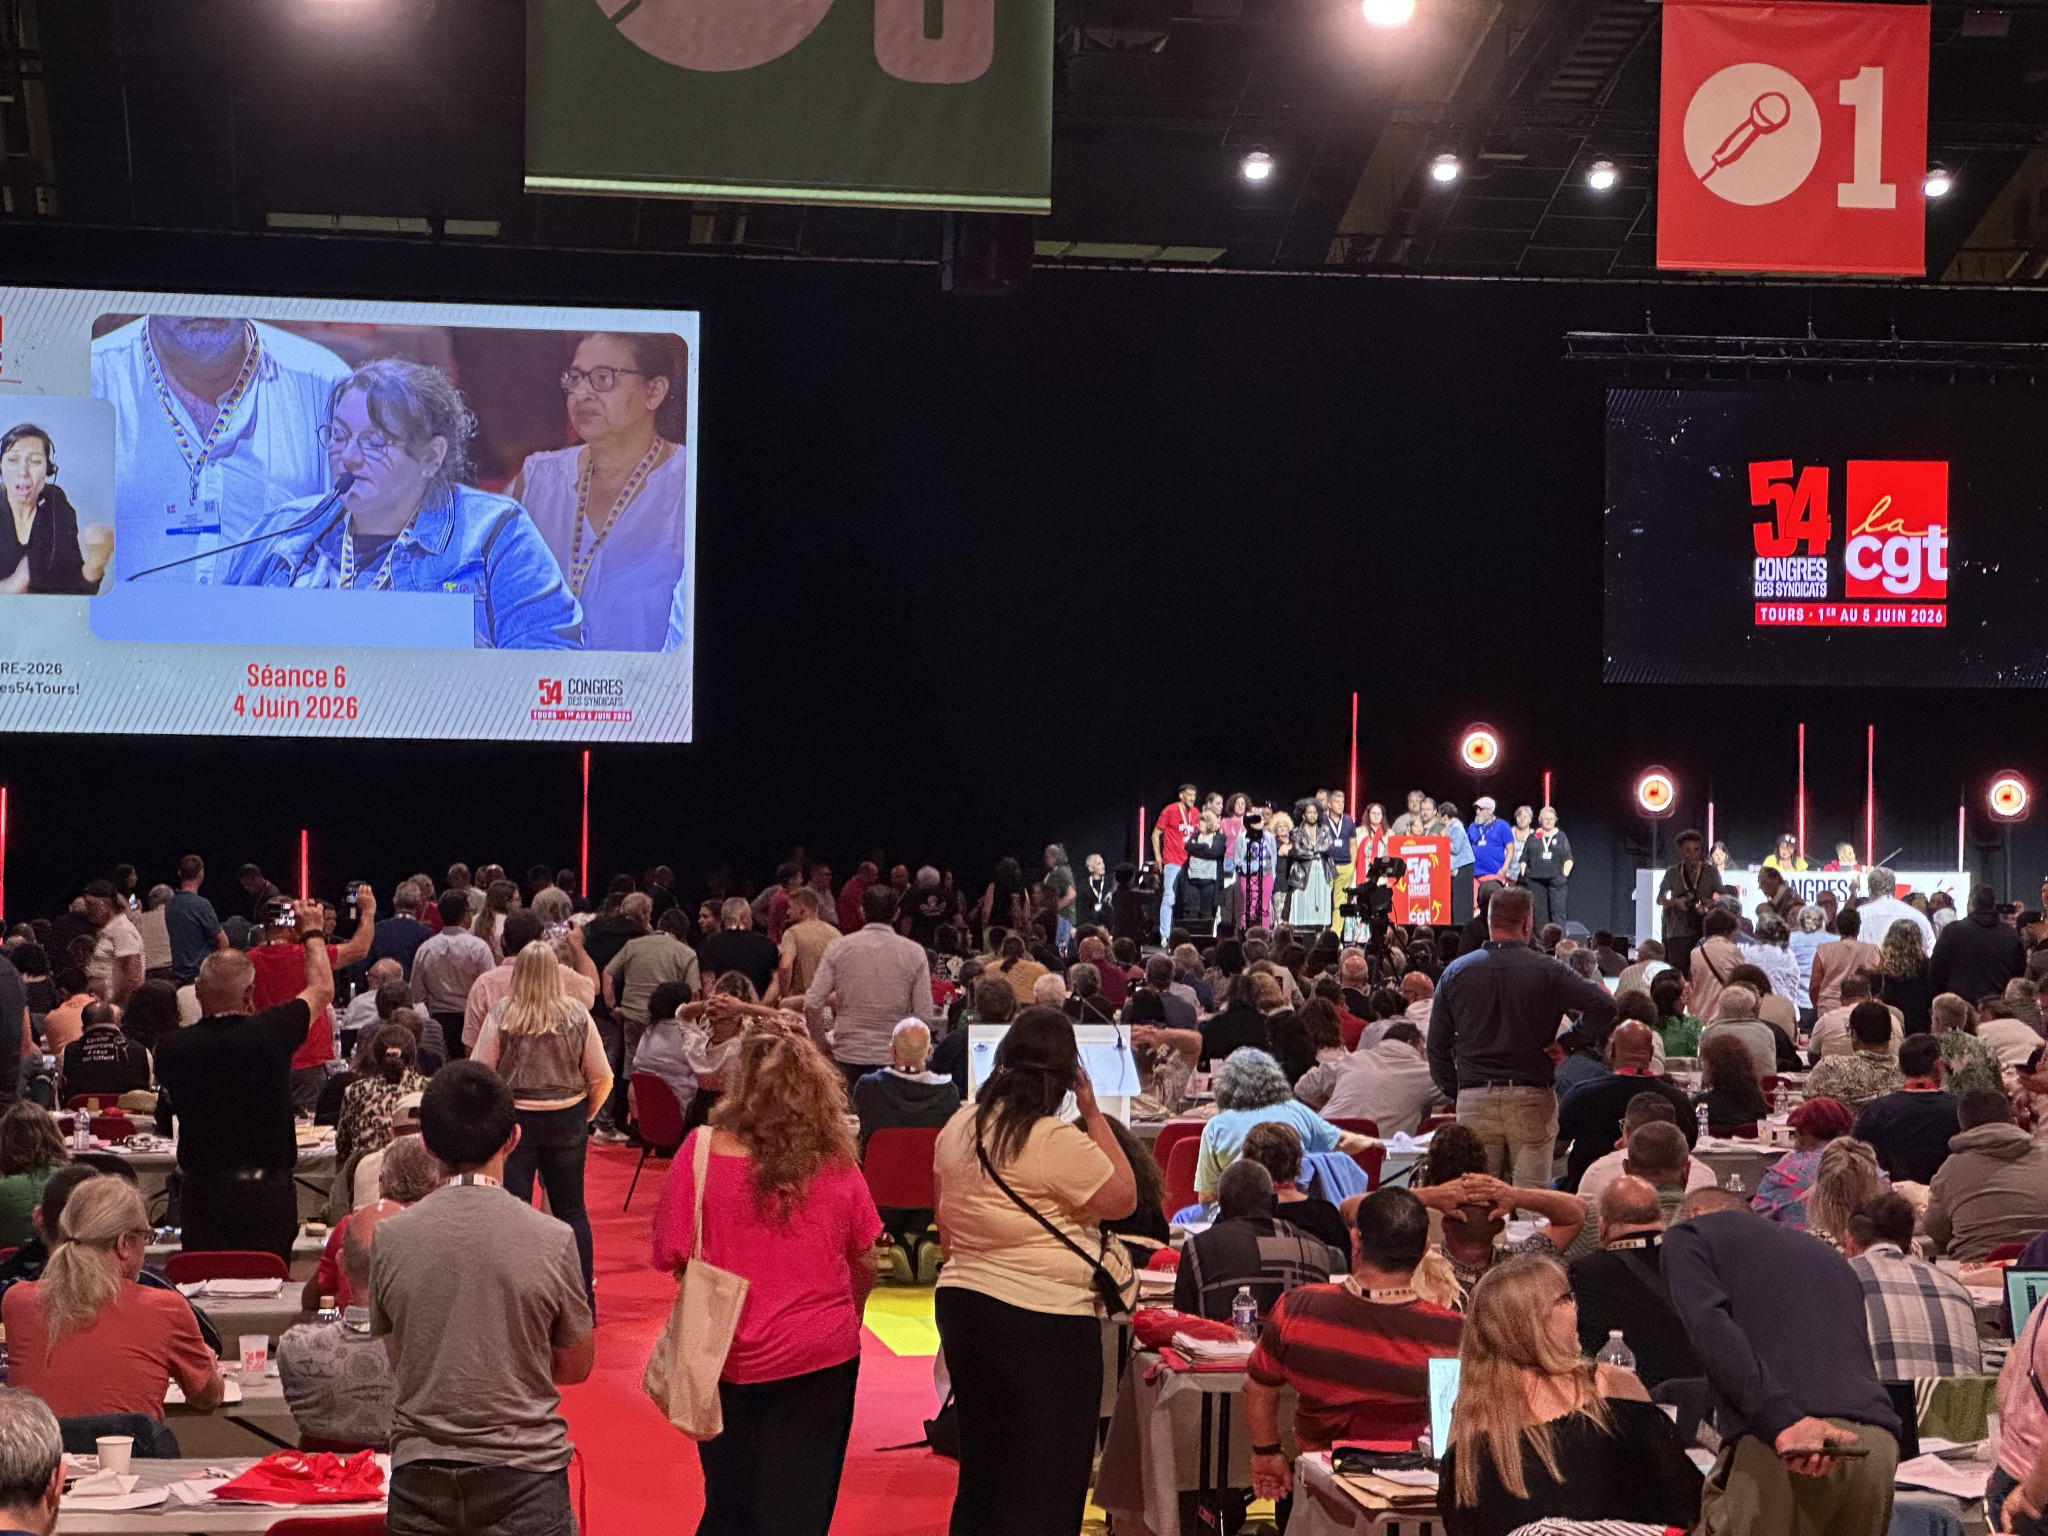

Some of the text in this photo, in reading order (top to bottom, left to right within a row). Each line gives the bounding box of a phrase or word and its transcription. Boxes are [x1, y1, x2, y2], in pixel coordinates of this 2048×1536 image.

[1837, 66, 1897, 209] 1
[1852, 494, 1947, 537] la
[1755, 557, 1828, 582] CONGRES
[1845, 524, 1949, 594] cgt
[1755, 582, 1828, 598] DES SYNDICATS
[1760, 607, 1804, 622] TOURS
[1840, 608, 1858, 623] AU
[1863, 609, 1870, 623] 5
[1874, 609, 1906, 623] JUIN
[1911, 609, 1943, 623] 2026
[247, 662, 346, 689] Séance 6
[568, 678, 624, 696] CONGRES
[538, 677, 563, 706] 54
[567, 696, 624, 707] DES SYNDICATS
[233, 694, 358, 720] 4 Juin 2026
[1408, 908, 1431, 926] cgt
